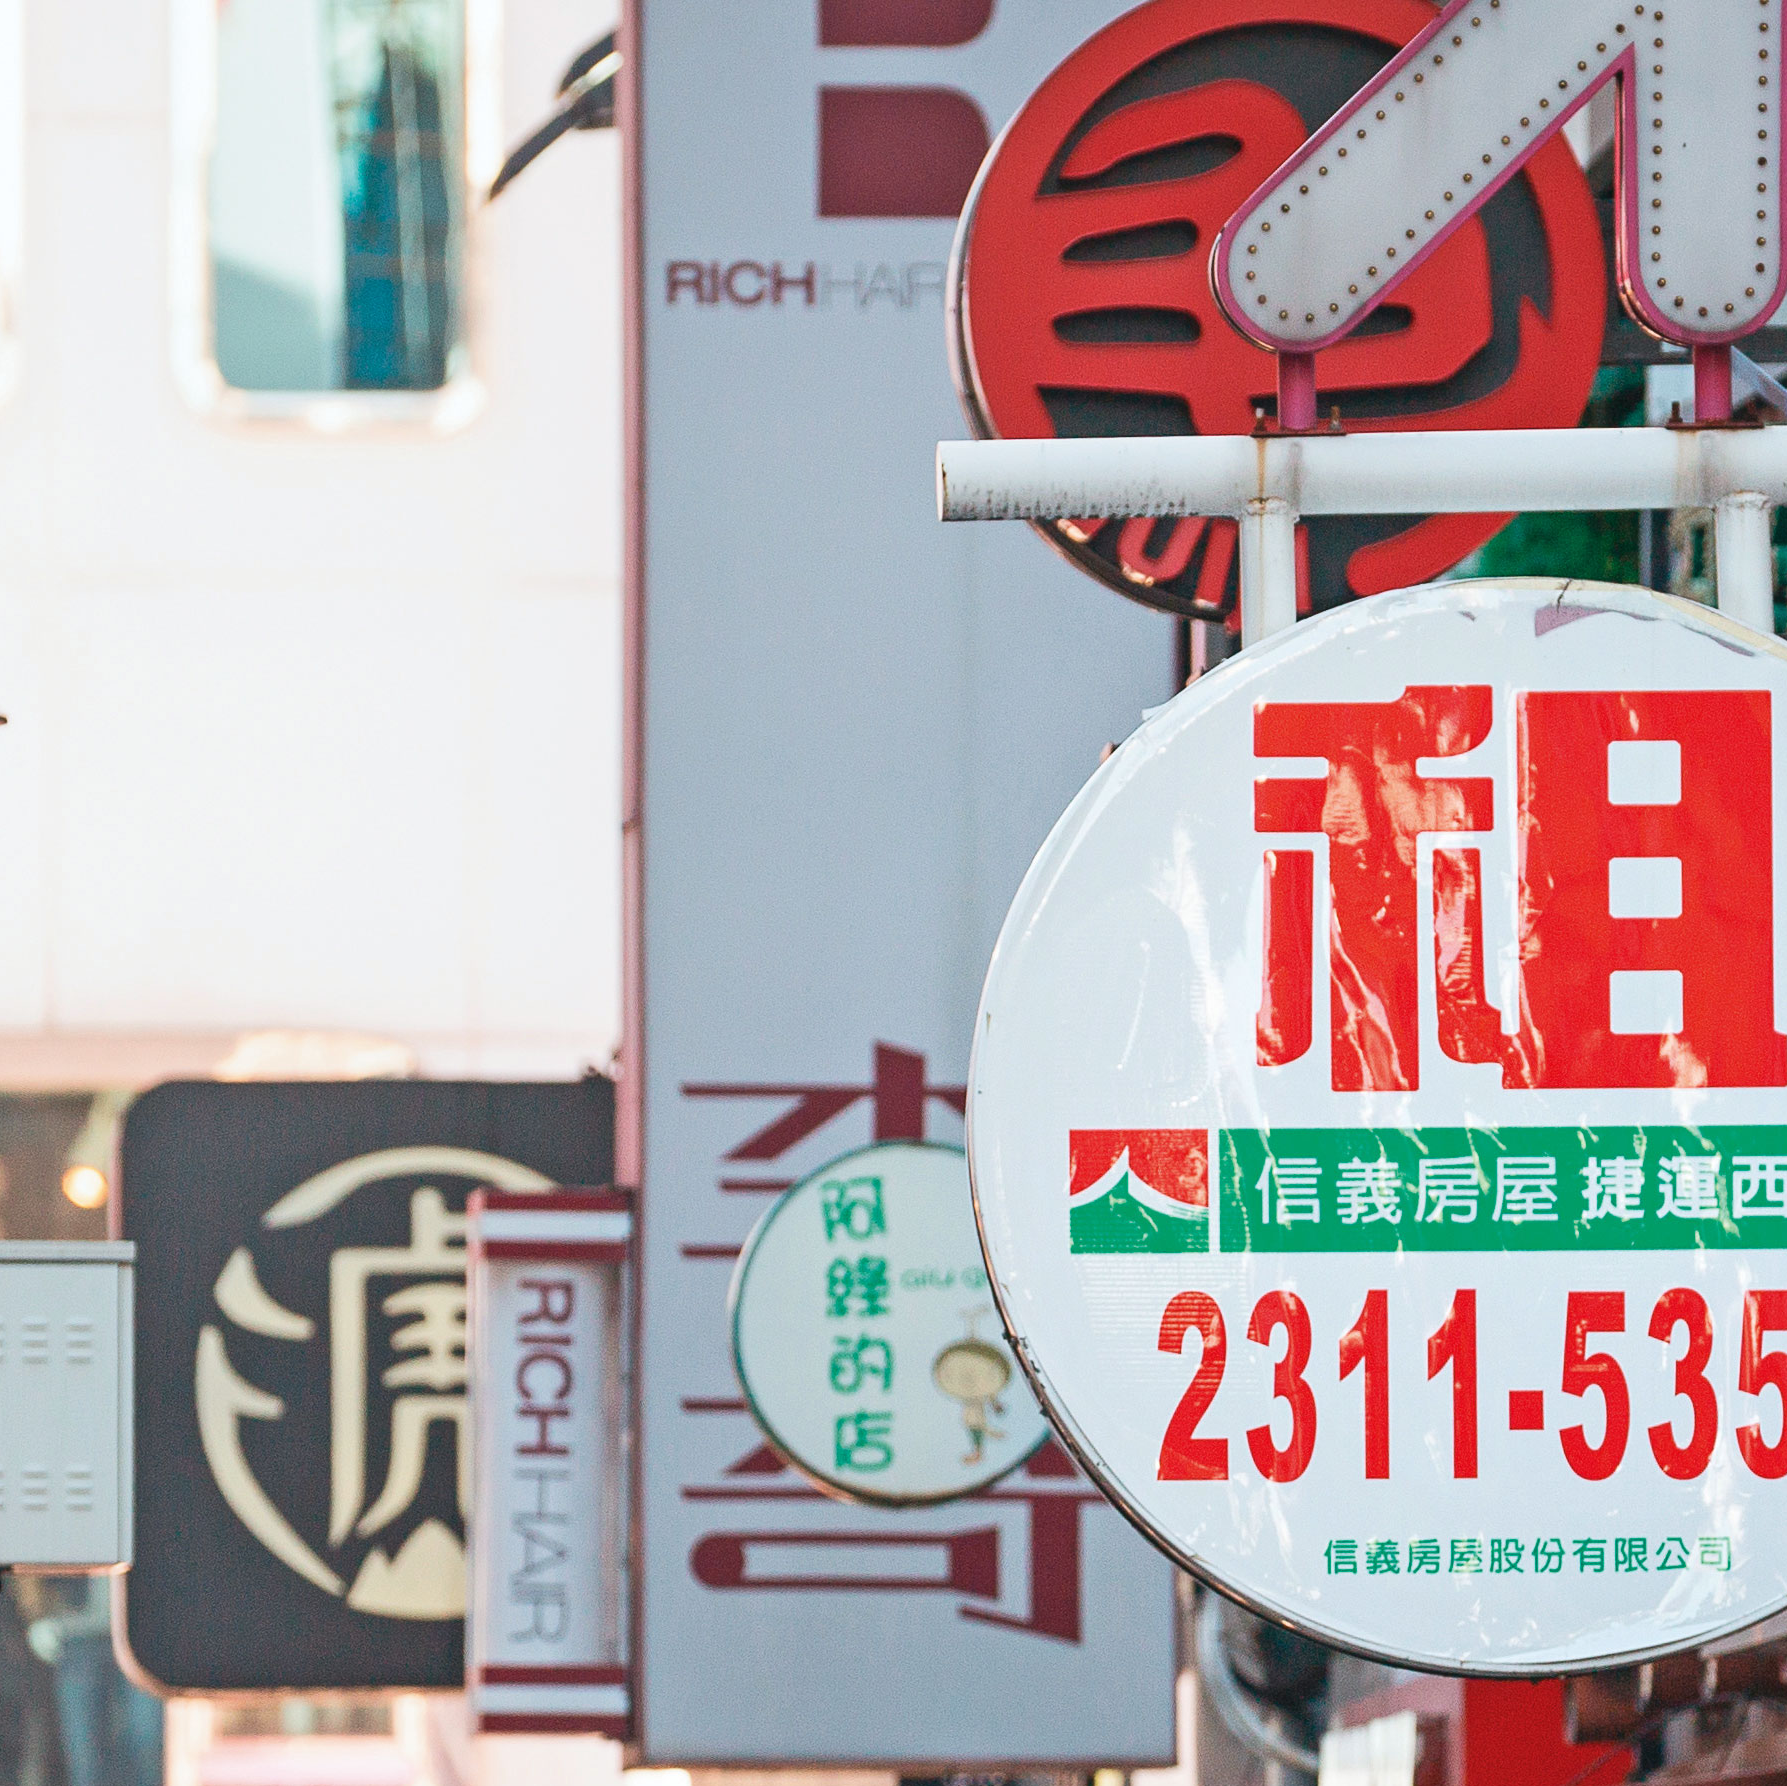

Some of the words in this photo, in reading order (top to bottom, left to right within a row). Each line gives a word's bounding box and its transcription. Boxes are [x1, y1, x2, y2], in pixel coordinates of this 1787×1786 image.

[1255, 1155, 1561, 1227] 信義房屋
[1322, 1536, 1734, 1576] 信義房屋股份有限公司
